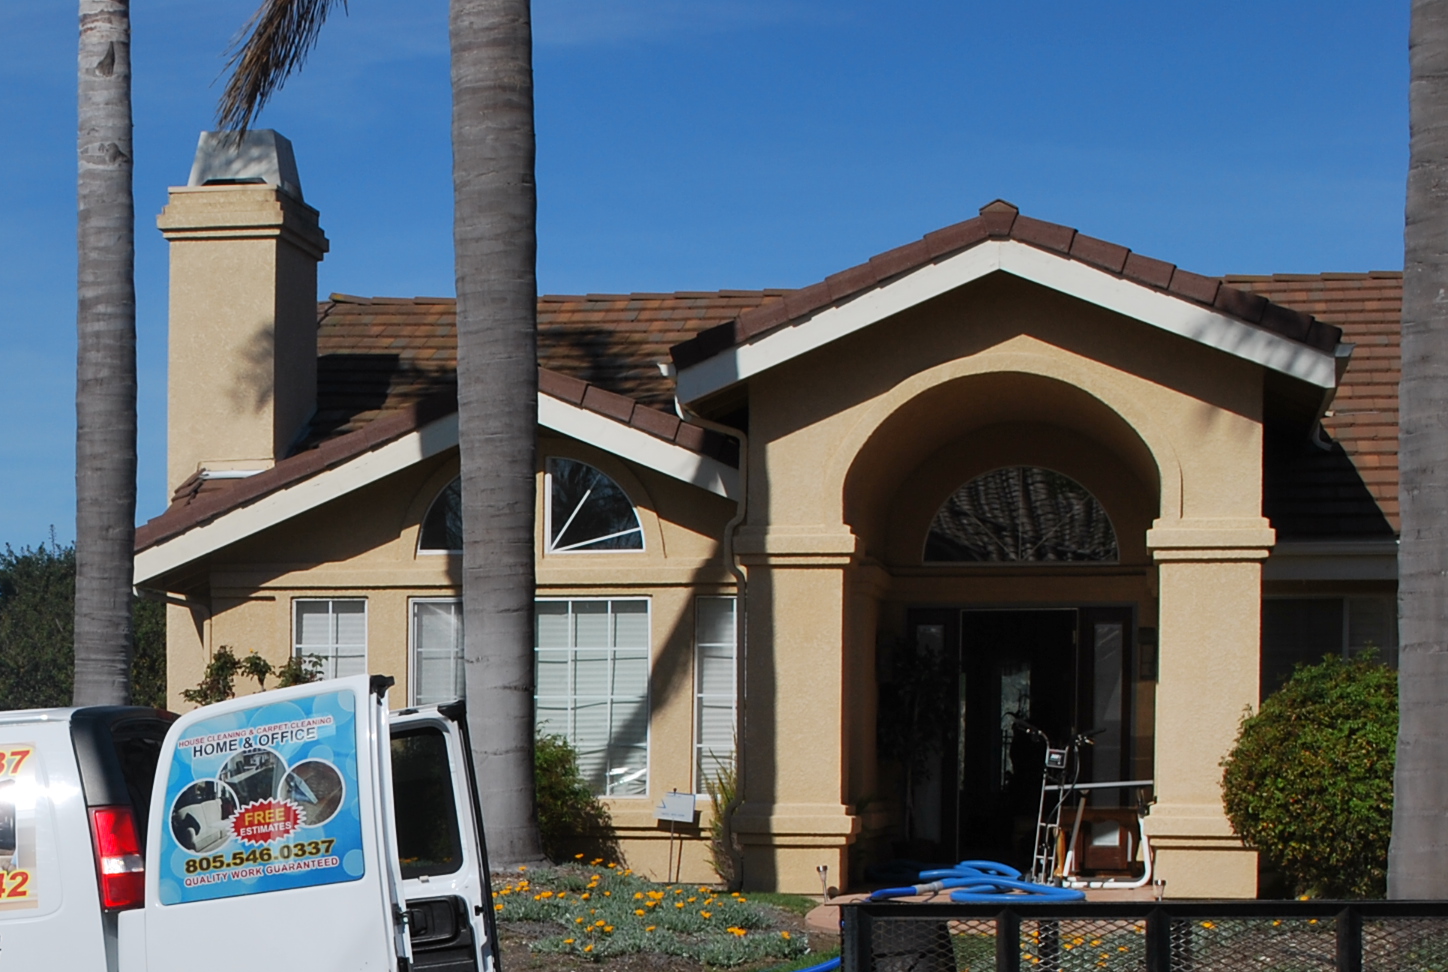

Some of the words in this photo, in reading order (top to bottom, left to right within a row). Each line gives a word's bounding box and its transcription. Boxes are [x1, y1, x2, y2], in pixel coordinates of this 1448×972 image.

[178, 737, 205, 748] HOUSE
[207, 731, 246, 742] CLEANING
[256, 724, 289, 734] CARPET
[290, 717, 332, 729] CLEANING
[193, 739, 238, 758] HOME
[243, 736, 253, 748] &
[258, 727, 316, 747] OFFICE
[240, 821, 292, 836] ESTIMATES
[245, 808, 285, 826] FREE
[185, 839, 336, 874] 805.546.0337
[185, 872, 228, 887] QUALITY
[231, 867, 263, 879] WORK
[265, 857, 339, 875] GUARANTEED
